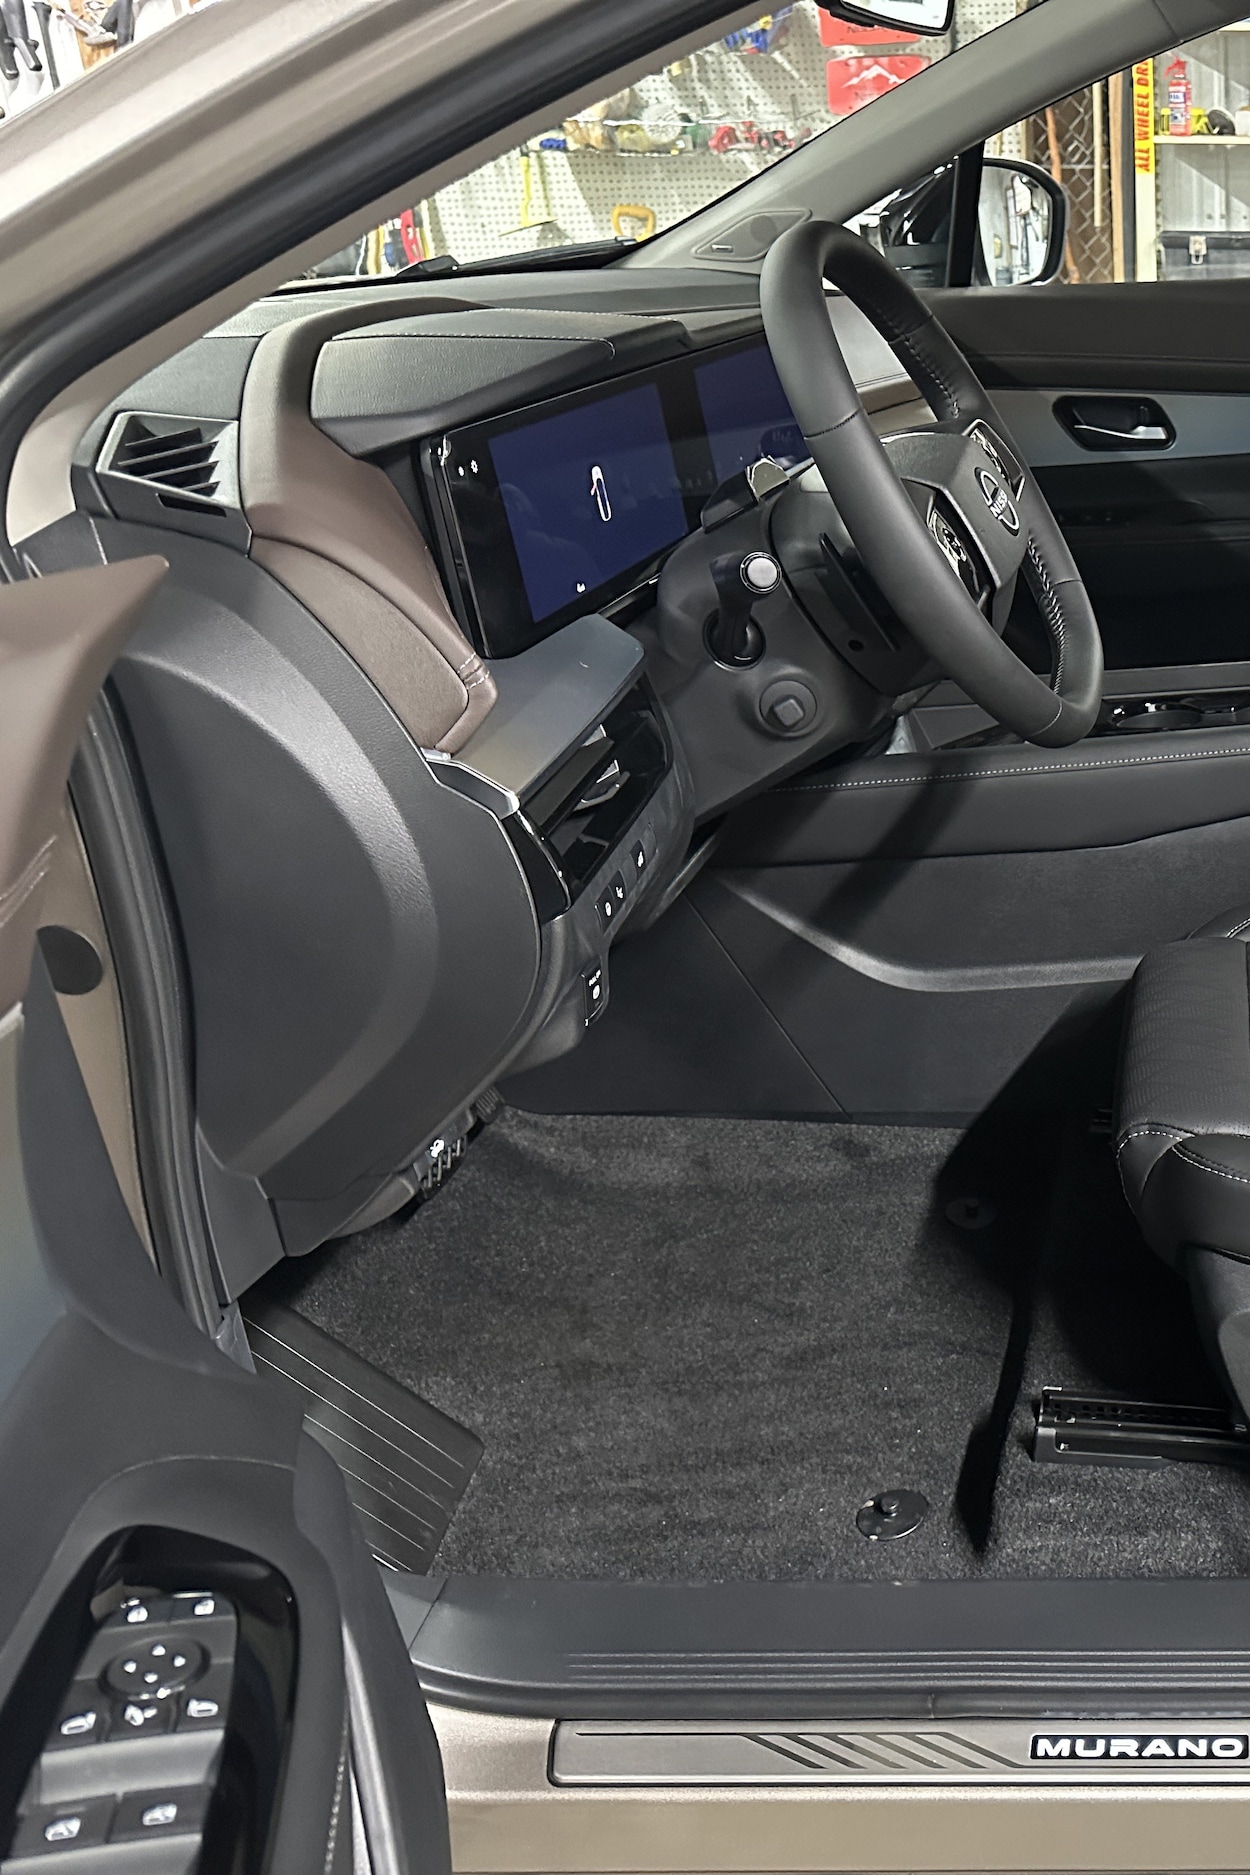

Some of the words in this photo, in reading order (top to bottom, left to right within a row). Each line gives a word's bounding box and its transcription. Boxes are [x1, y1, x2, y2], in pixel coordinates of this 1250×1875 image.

[1135, 92, 1150, 142] WHEEL
[1135, 147, 1150, 172] ALL
[1036, 1738, 1243, 1758] MURANO
